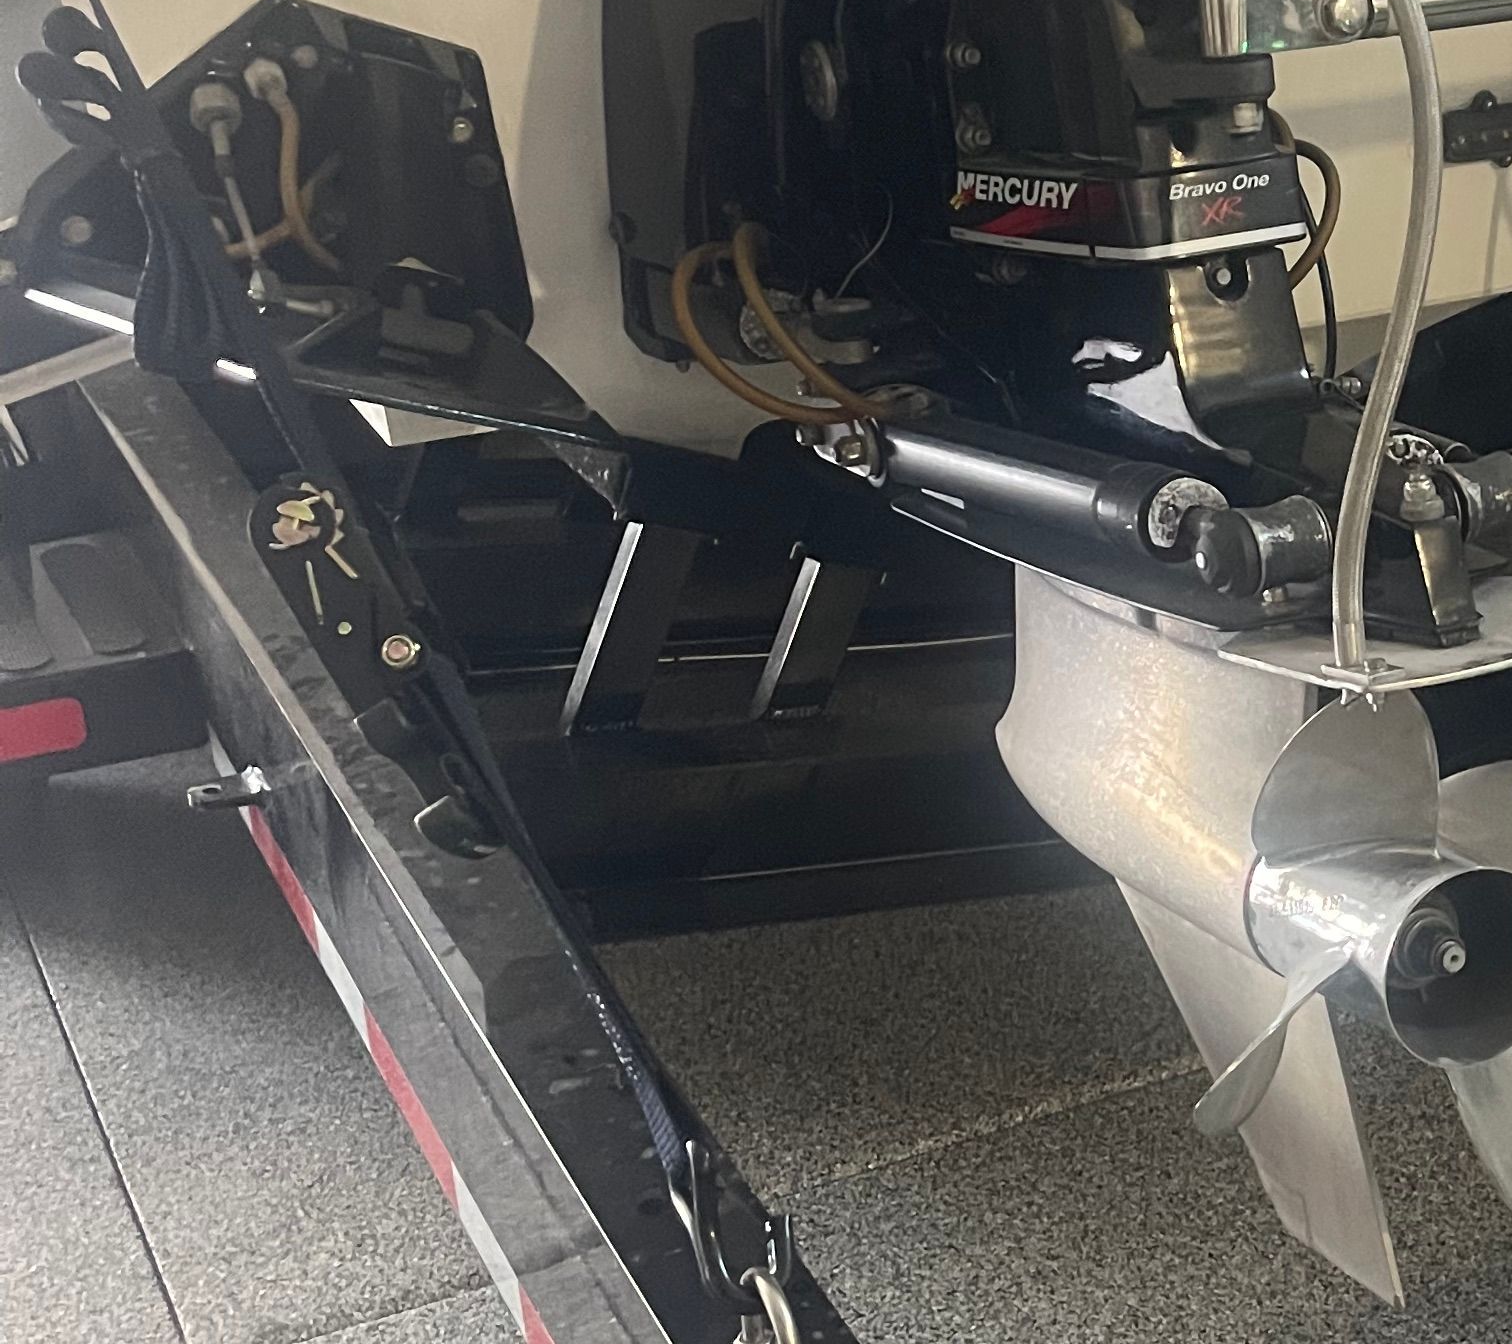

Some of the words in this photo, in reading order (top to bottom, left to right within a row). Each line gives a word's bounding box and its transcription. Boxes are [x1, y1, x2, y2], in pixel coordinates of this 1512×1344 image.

[950, 171, 1077, 210] MERCURY
[1169, 181, 1227, 201] Bravo
[1232, 174, 1270, 190] One
[1201, 196, 1245, 226] XR
